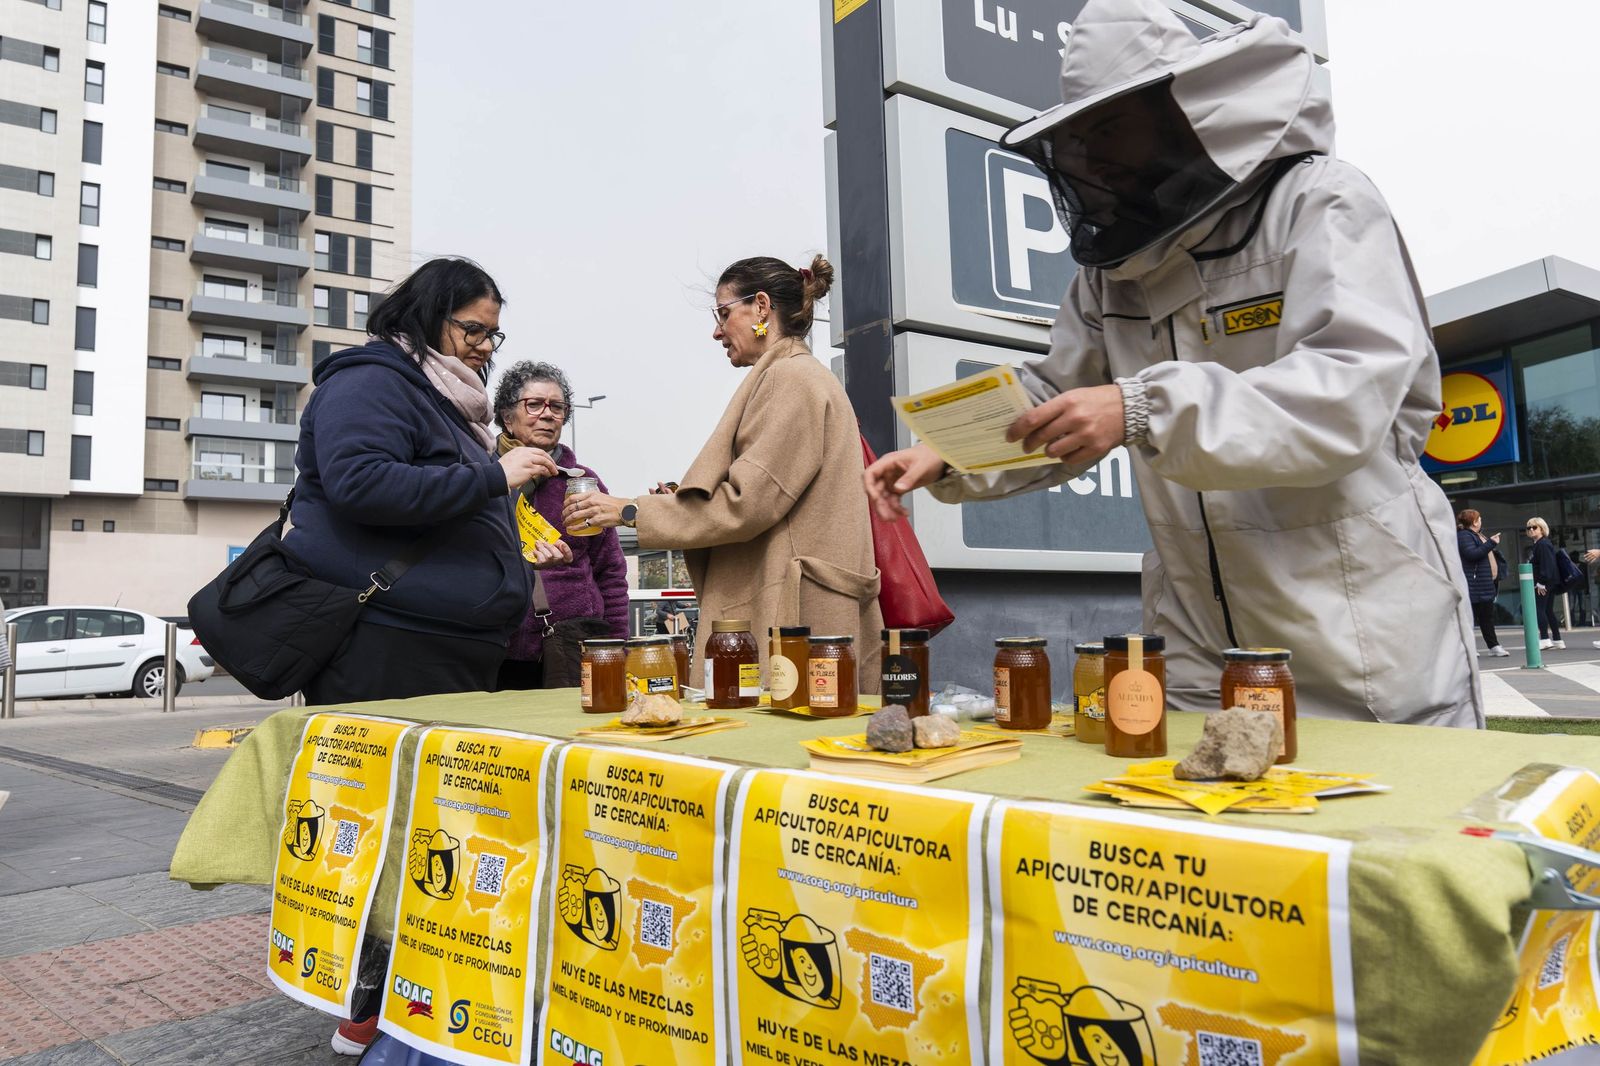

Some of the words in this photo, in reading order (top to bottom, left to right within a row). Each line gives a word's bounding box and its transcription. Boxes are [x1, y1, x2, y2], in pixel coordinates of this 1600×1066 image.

[974, 0, 1018, 42] Lu
[1003, 167, 1071, 291] P
[1248, 693, 1268, 701] MIEL
[1251, 703, 1281, 712] FLORES
[306, 735, 387, 757] APICULTOR/APICULTORA
[333, 724, 357, 737] BUSCA
[358, 727, 370, 738] TU
[317, 751, 329, 763] DE
[328, 753, 363, 769] CERCANÍA:
[456, 740, 485, 755] BUSCA
[489, 745, 502, 758] TU
[425, 753, 532, 782] APICULTOR/APICULTORA
[606, 765, 645, 785] BUSCA
[648, 772, 664, 788] TU
[443, 773, 453, 786] DE
[454, 775, 503, 796] CERCANÍA:
[569, 778, 705, 819] APICULTOR/APICULTORA
[594, 803, 608, 819] DE
[610, 806, 670, 833] CERCANÍA:
[808, 793, 860, 818] BUSCA
[867, 803, 889, 823] TU
[583, 829, 679, 861] www.coag.org/apicultura
[754, 807, 952, 862] APICULTOR/APICULTORA
[791, 837, 809, 856] DE
[814, 842, 901, 877] CERCANÍA:
[1089, 840, 1165, 871] BUSCA
[1174, 853, 1207, 877] TU
[280, 873, 293, 888] HUYE
[293, 879, 301, 891] DE
[301, 883, 315, 896] LAS
[315, 886, 355, 908] MEZCLAS
[777, 867, 919, 909] www.coag.org/apicultura
[1015, 857, 1306, 926] APICULTOR/APICULTORA
[287, 898, 304, 912] VERDAD
[305, 904, 310, 915] Y
[310, 906, 318, 917] DE
[318, 909, 357, 929] PROXIMIDAD
[1072, 894, 1099, 917] DE
[1106, 900, 1234, 942] CERCANÍA:
[273, 928, 295, 953] COAG
[406, 912, 425, 931] HUYE
[426, 920, 437, 935] DE
[438, 924, 457, 940] LAS
[459, 930, 513, 955] MEZCLAS
[399, 932, 410, 946] MIEL
[410, 937, 418, 949] DE
[418, 941, 444, 959] VERDAD
[446, 951, 453, 961] Y
[453, 953, 464, 966] DE
[465, 955, 522, 979] PROXIMIDAD
[1053, 928, 1260, 984] www.coag.org/apicultura
[316, 971, 342, 991] CECU
[394, 975, 432, 1005] COAG
[561, 960, 586, 982] HUYE
[588, 972, 602, 988] DE
[603, 976, 626, 999] LAS
[628, 986, 695, 1017] MEZCLAS
[552, 981, 569, 998] MIEL
[569, 988, 580, 1004] DE
[580, 994, 612, 1018] VERDAD
[614, 1008, 622, 1021] Y
[624, 1011, 637, 1026] DE
[638, 1016, 709, 1044] PROXIMIDAD
[473, 1026, 513, 1048] CECU
[551, 1029, 603, 1066] COAG
[746, 1040, 774, 1060] MIEL
[776, 1050, 791, 1066] DE
[757, 1017, 799, 1044] HUYE
[803, 1032, 823, 1051] DE
[827, 1039, 858, 1062] LAS
